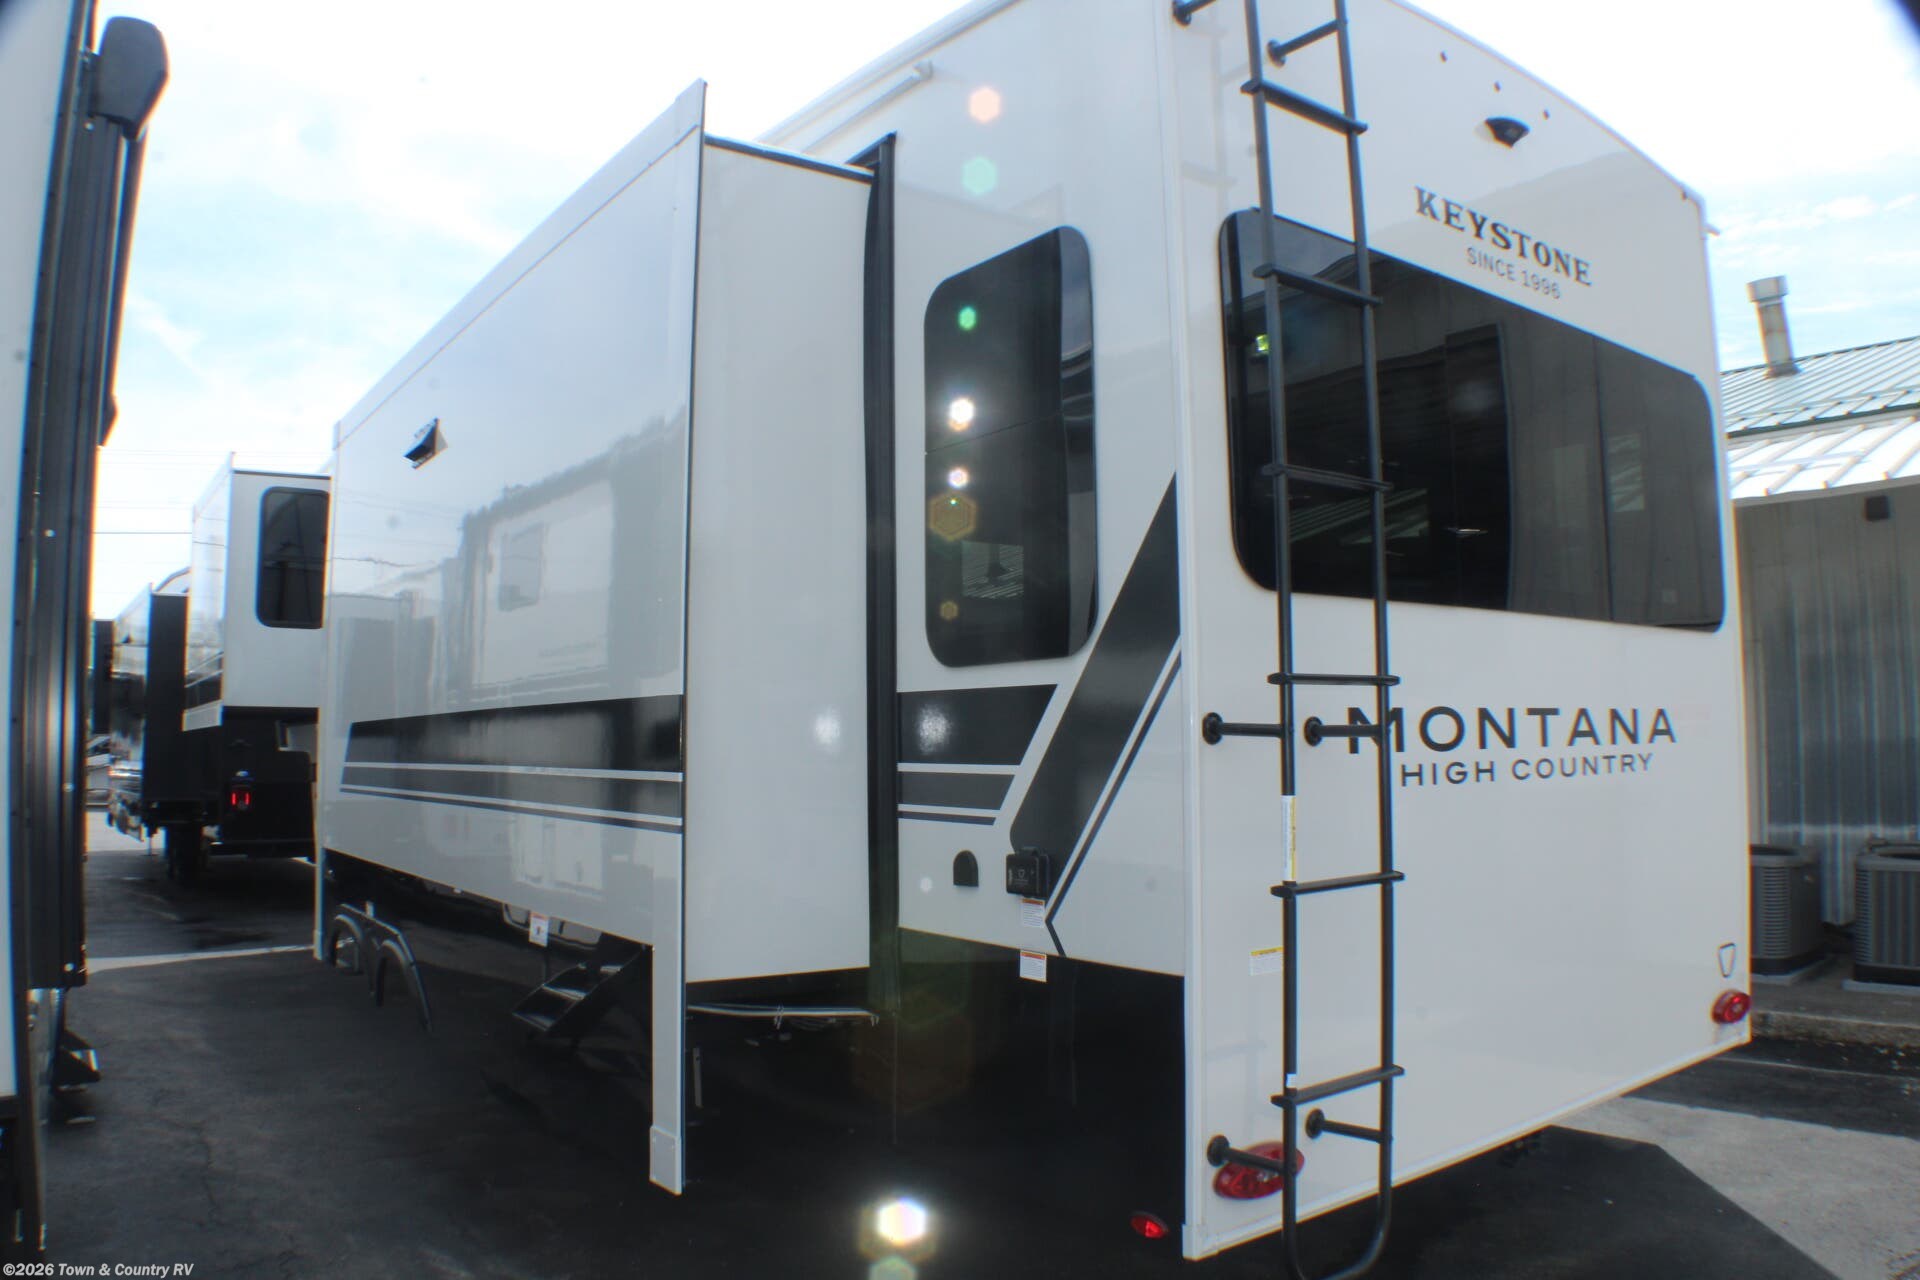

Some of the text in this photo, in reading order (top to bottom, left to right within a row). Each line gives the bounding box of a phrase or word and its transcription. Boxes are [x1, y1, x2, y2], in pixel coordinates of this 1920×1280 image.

[1415, 185, 1592, 287] KEYSTONE
[1466, 247, 1561, 300] SINCE 1996
[1347, 706, 1676, 754] MONTANA
[1401, 753, 1653, 787] HIGH COUNTRY
